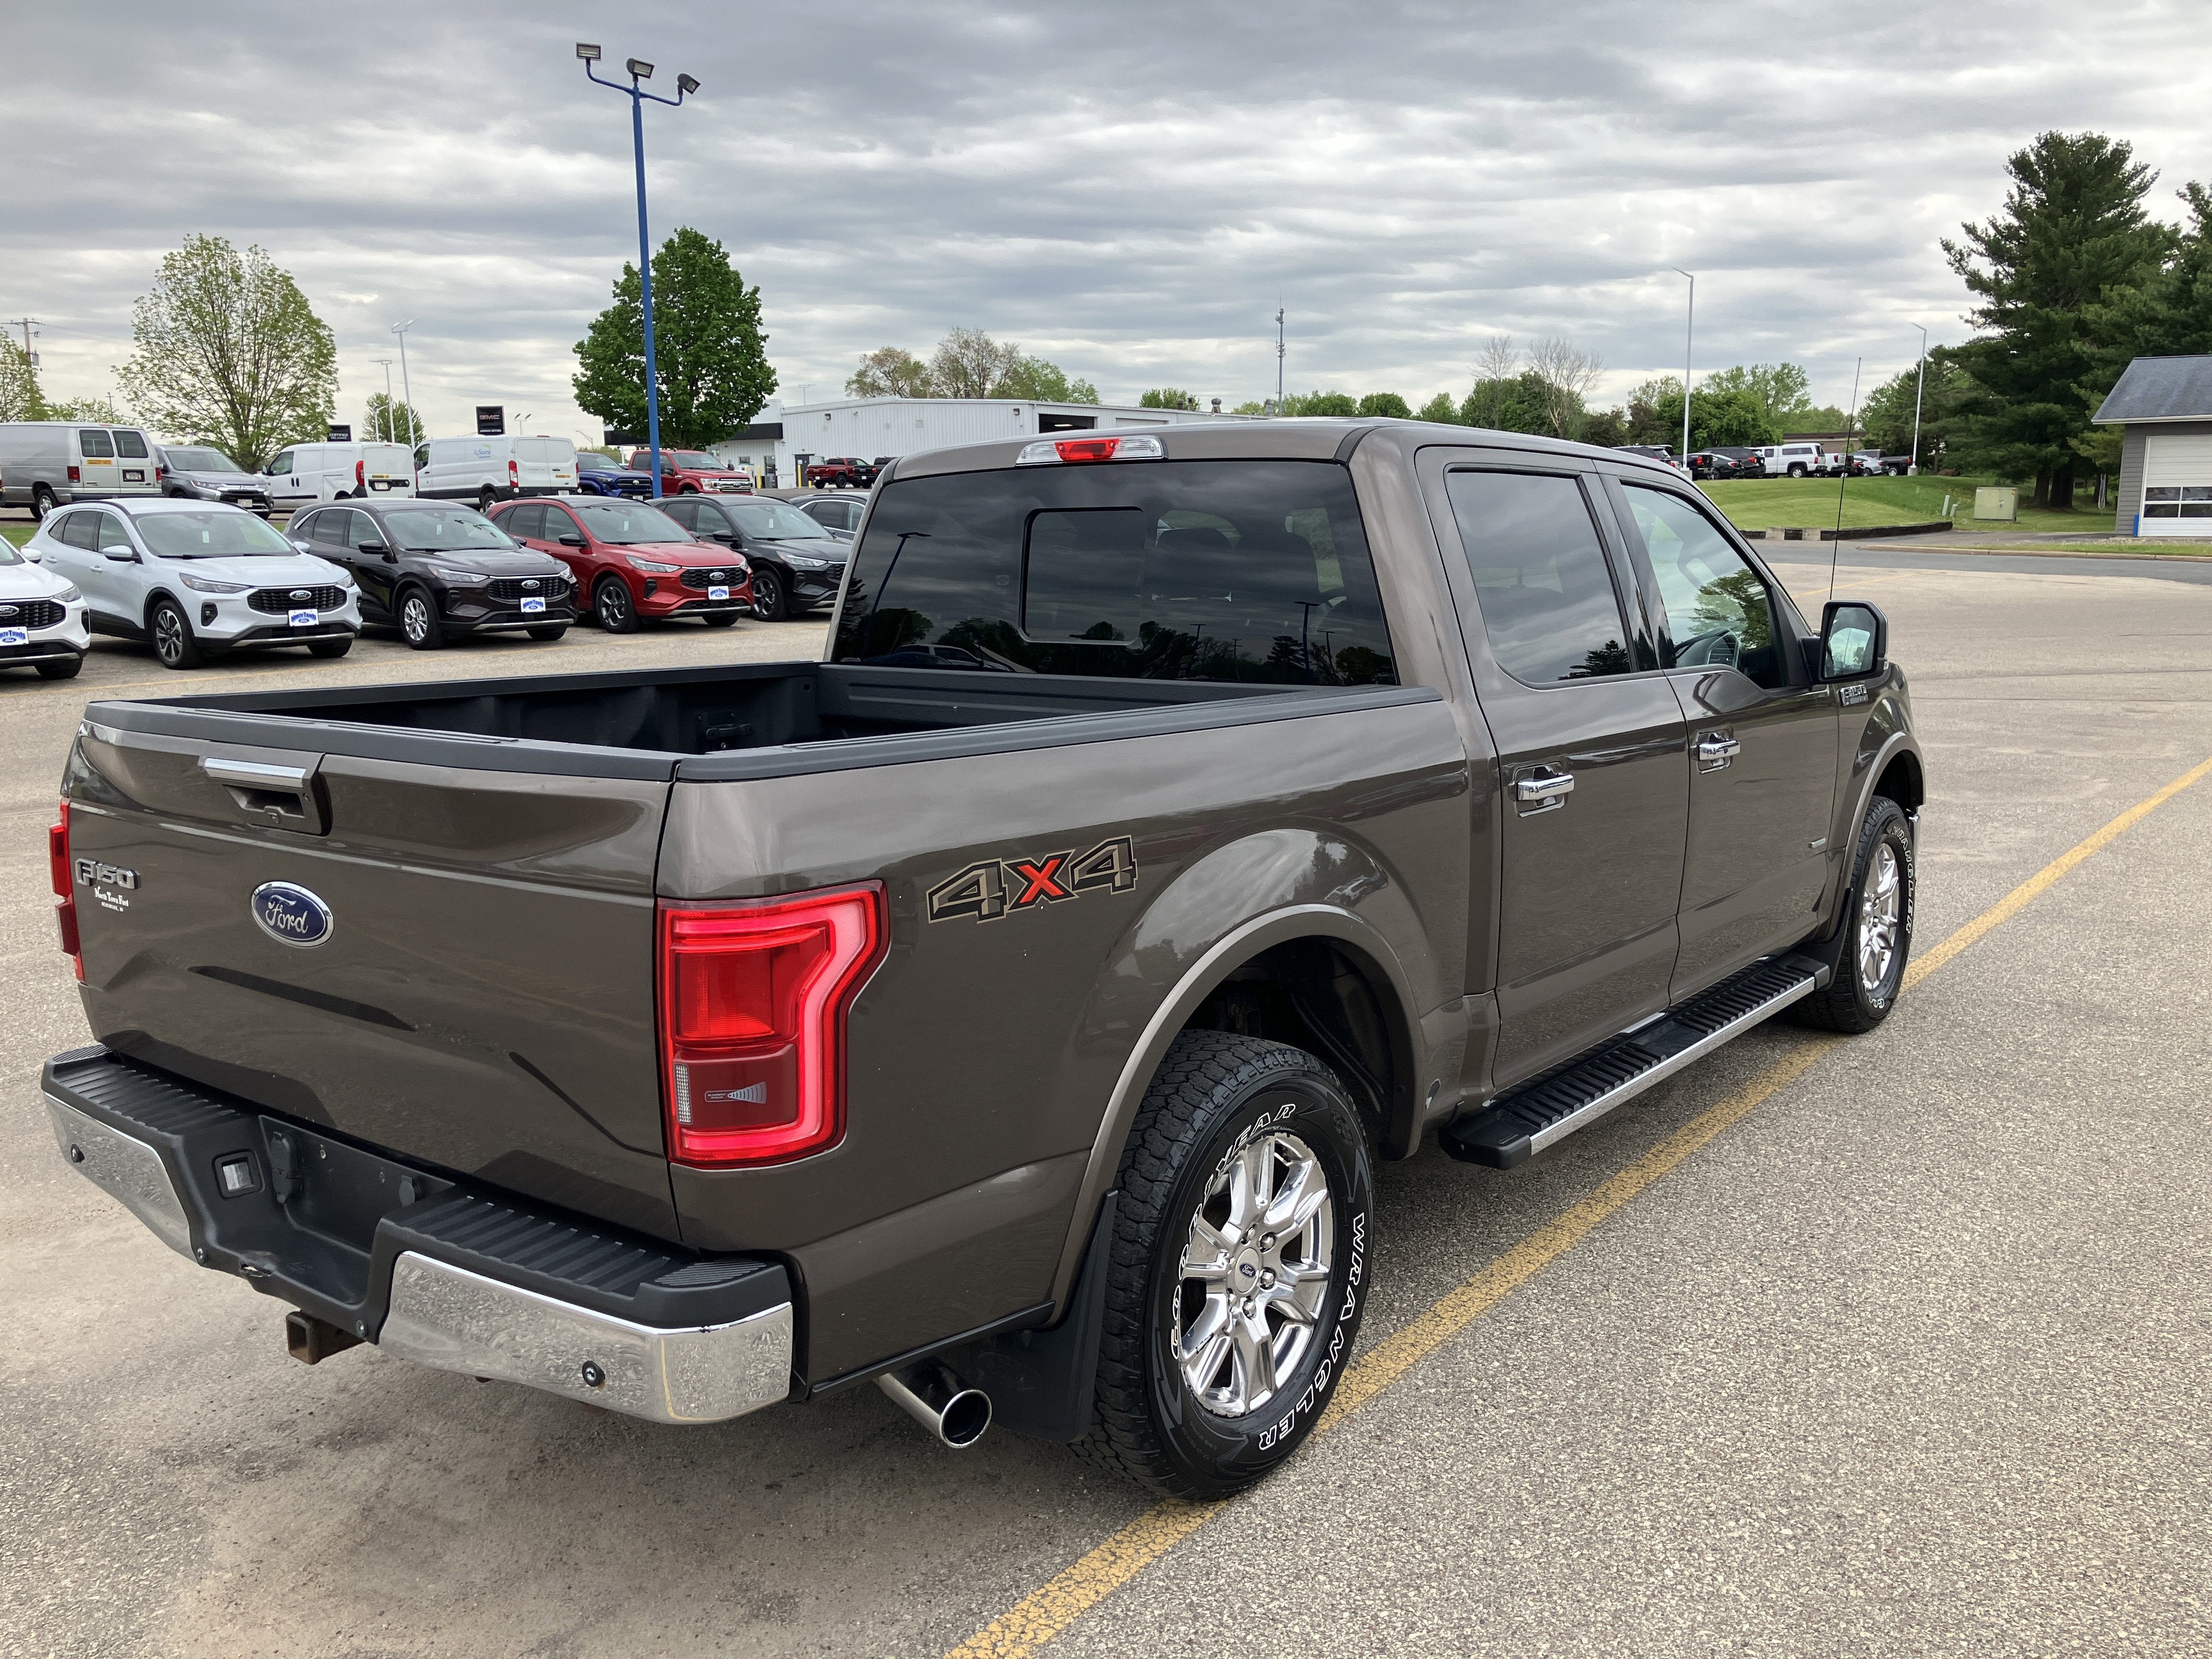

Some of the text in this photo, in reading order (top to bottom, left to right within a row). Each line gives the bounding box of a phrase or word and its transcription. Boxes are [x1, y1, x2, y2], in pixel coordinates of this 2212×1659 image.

[266, 894, 308, 934] Ford
[1892, 826, 1914, 934] WRANGLER
[1259, 1212, 1365, 1451] WRANGLER
